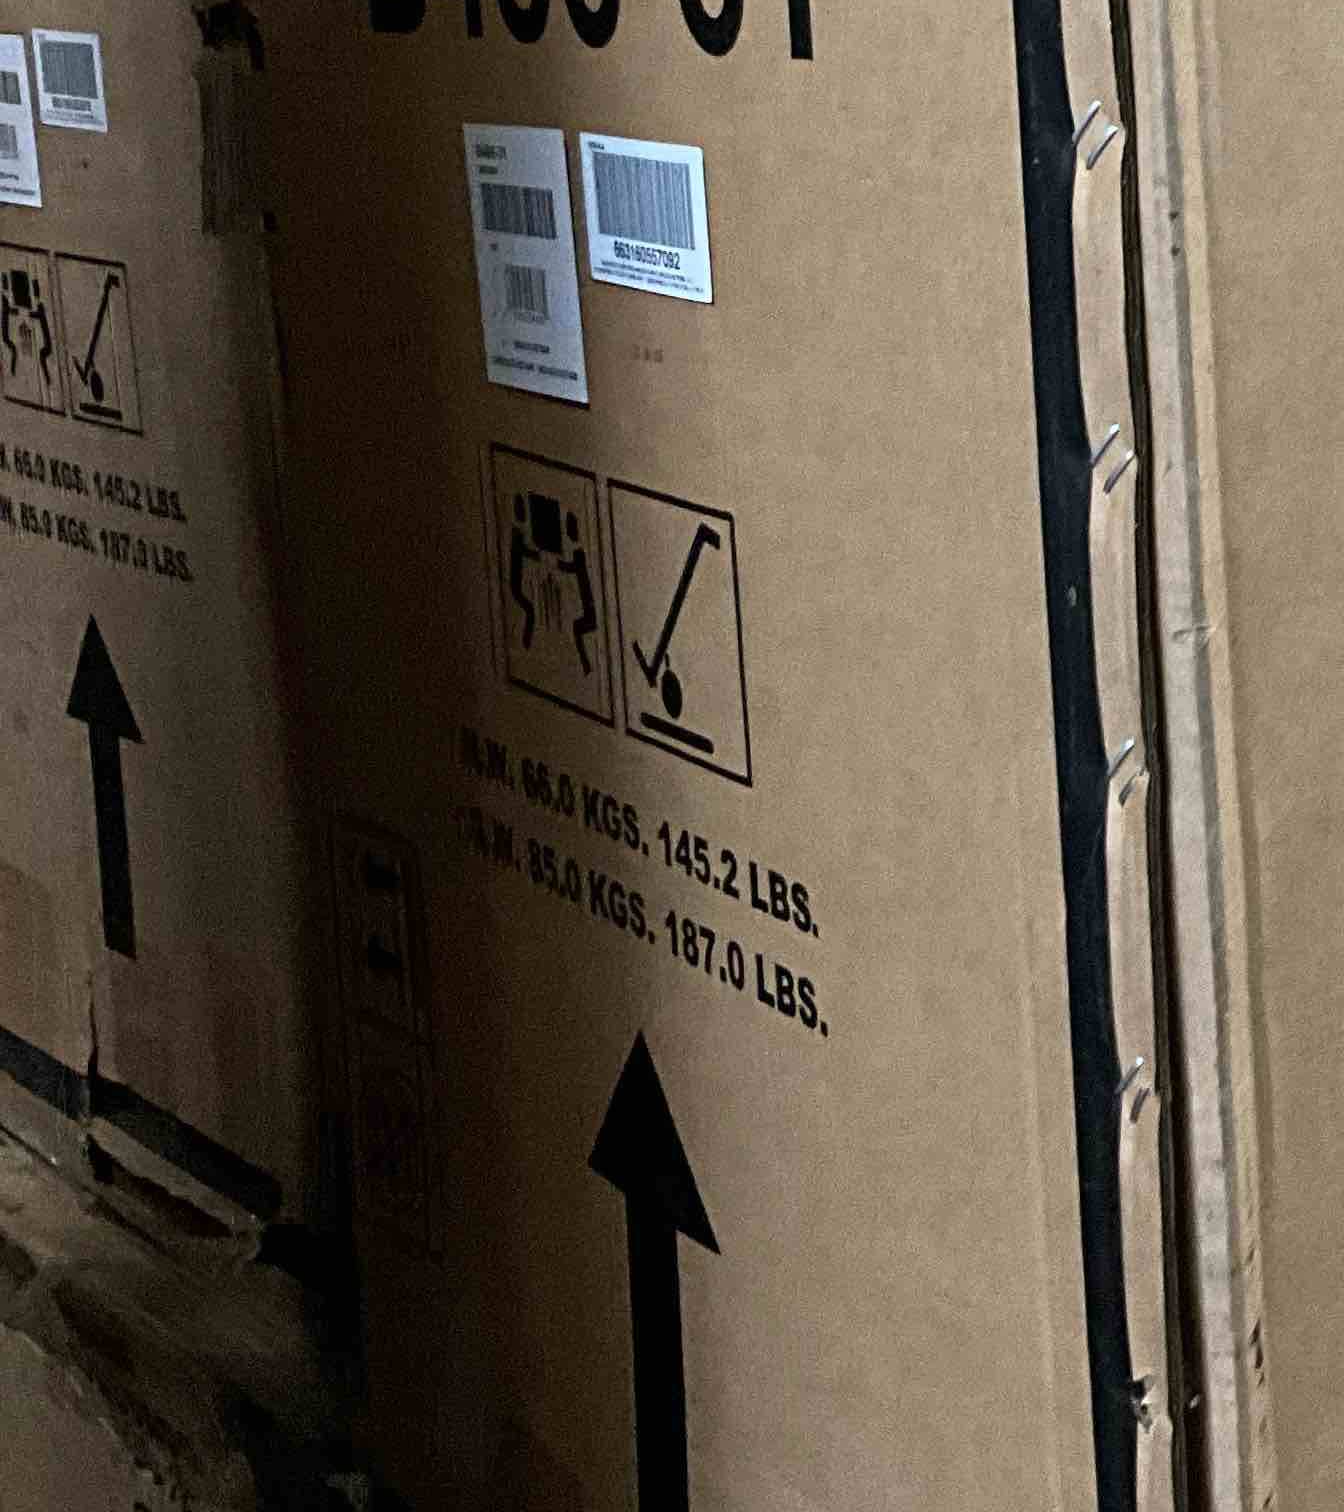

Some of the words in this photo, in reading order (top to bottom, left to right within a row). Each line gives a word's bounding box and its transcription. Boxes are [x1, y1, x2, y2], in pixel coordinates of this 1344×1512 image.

[528, 837, 582, 903] 85.0
[664, 909, 745, 991] 187.0
[755, 953, 829, 1038] LBS.
[659, 820, 740, 899] 145.2
[749, 860, 820, 938] LBS.
